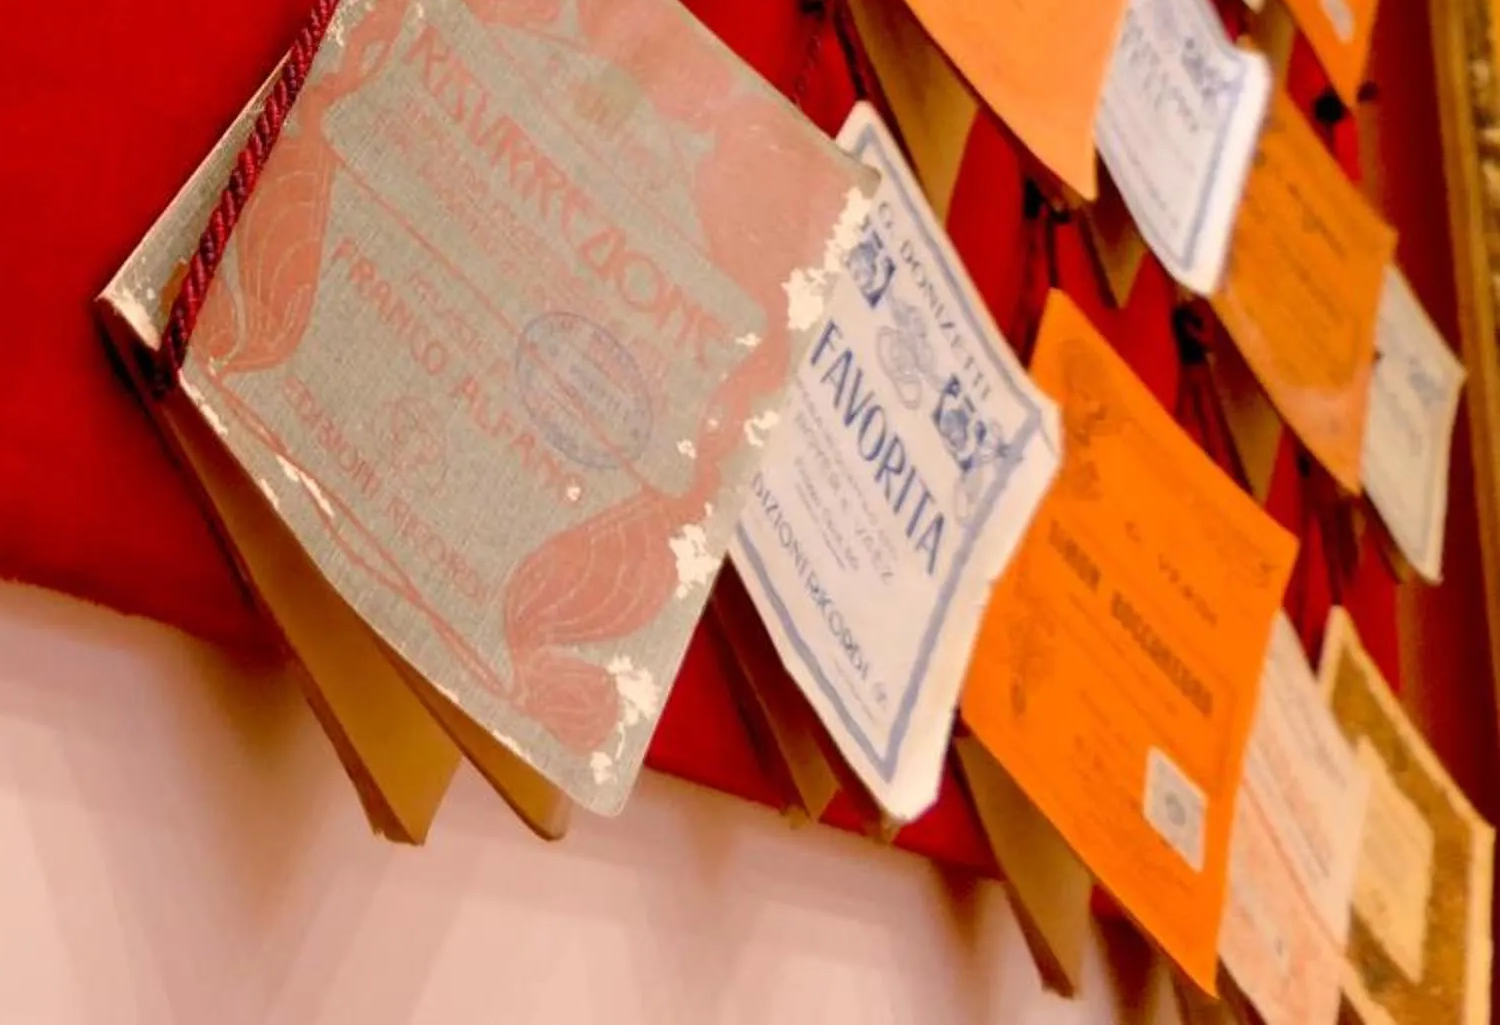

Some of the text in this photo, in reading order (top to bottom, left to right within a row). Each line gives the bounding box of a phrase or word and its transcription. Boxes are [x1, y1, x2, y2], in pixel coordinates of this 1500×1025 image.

[330, 235, 450, 380] FRANCO
[450, 371, 587, 511] ALFANO
[898, 236, 993, 406] DONIZETTI
[808, 311, 948, 578] FAVORITA
[750, 468, 808, 579] DIZIONI
[804, 566, 870, 684] RICORDI
